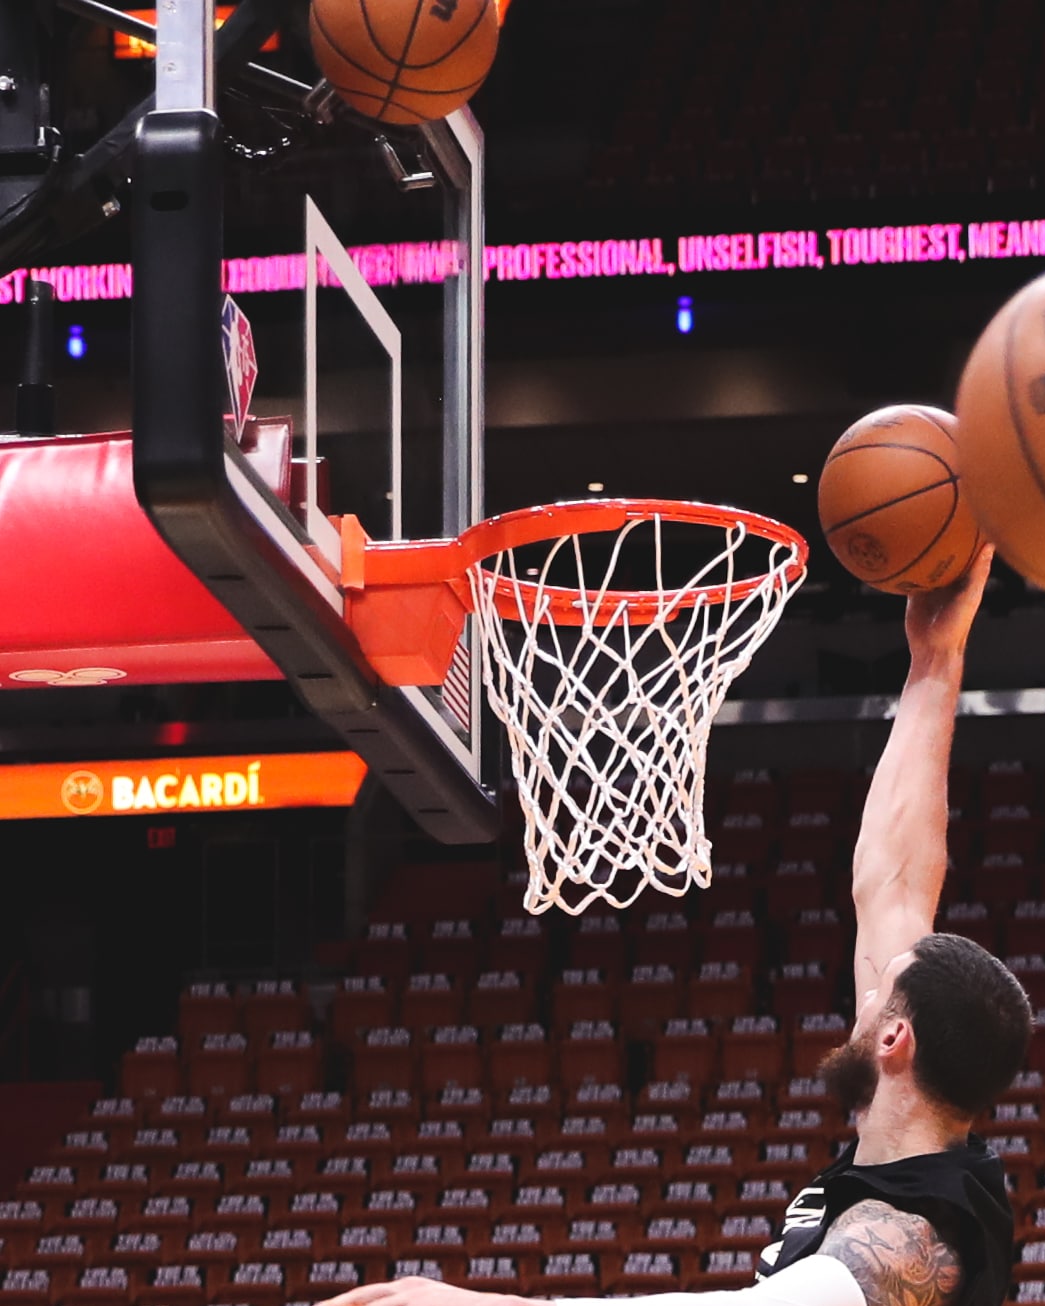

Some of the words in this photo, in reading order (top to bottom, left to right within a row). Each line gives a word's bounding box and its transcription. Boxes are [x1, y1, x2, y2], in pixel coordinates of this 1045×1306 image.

[483, 239, 675, 281] PROFESSIONAL,
[678, 231, 824, 272] UNSELFISH,
[826, 223, 965, 264] TOUGHEST,
[112, 761, 261, 810] BACARDÍ
